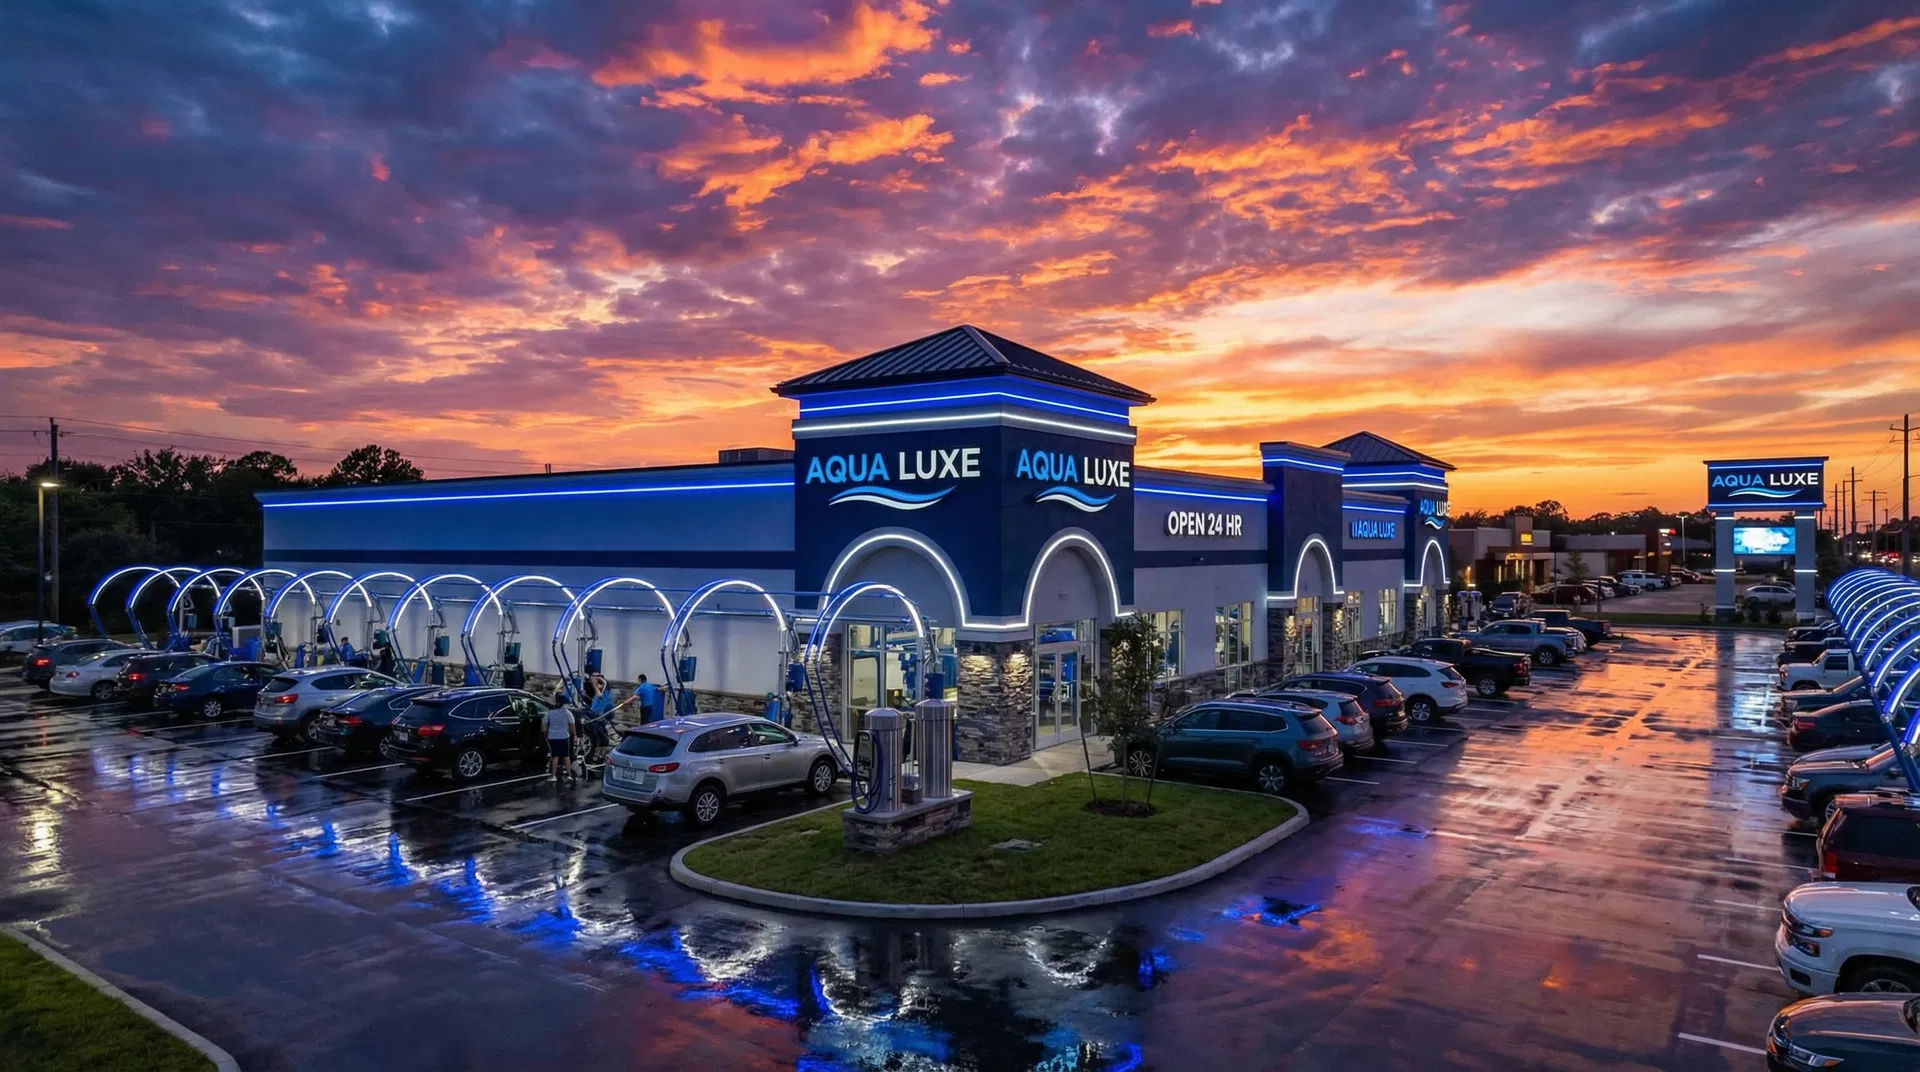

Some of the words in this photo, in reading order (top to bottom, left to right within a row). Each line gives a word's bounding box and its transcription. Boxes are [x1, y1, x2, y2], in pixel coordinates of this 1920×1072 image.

[806, 453, 890, 484] AQUA
[899, 448, 981, 483] LUXE
[1016, 449, 1079, 482] AQUA
[1083, 457, 1131, 487] LUXE
[1712, 473, 1765, 488] AQUA
[1769, 472, 1819, 486] LUXE
[1167, 510, 1205, 536] OPEN
[1207, 512, 1223, 536] 24
[1225, 514, 1242, 536] HR
